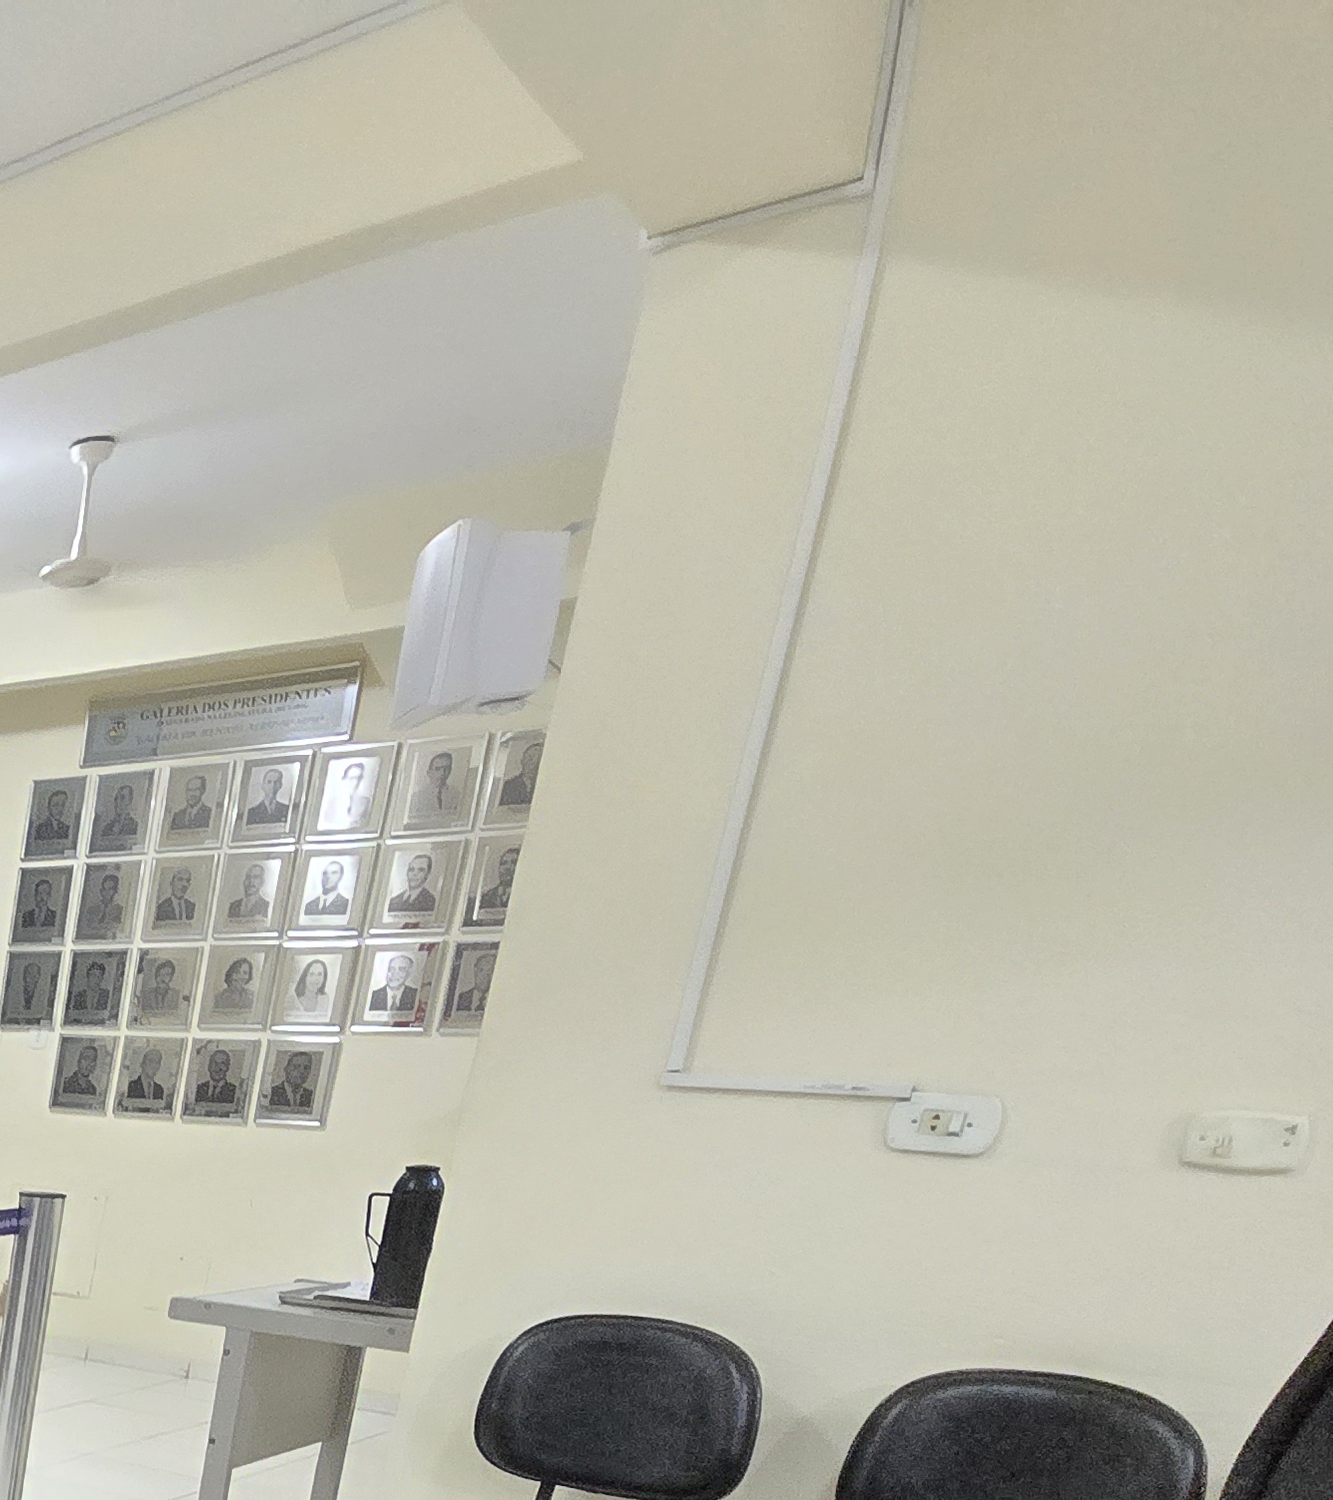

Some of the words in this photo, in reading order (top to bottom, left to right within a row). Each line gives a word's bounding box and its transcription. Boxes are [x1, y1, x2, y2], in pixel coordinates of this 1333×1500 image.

[140, 704, 199, 721] GALERIA
[202, 700, 231, 714] DOS
[233, 686, 332, 709] PRESIDENTES
